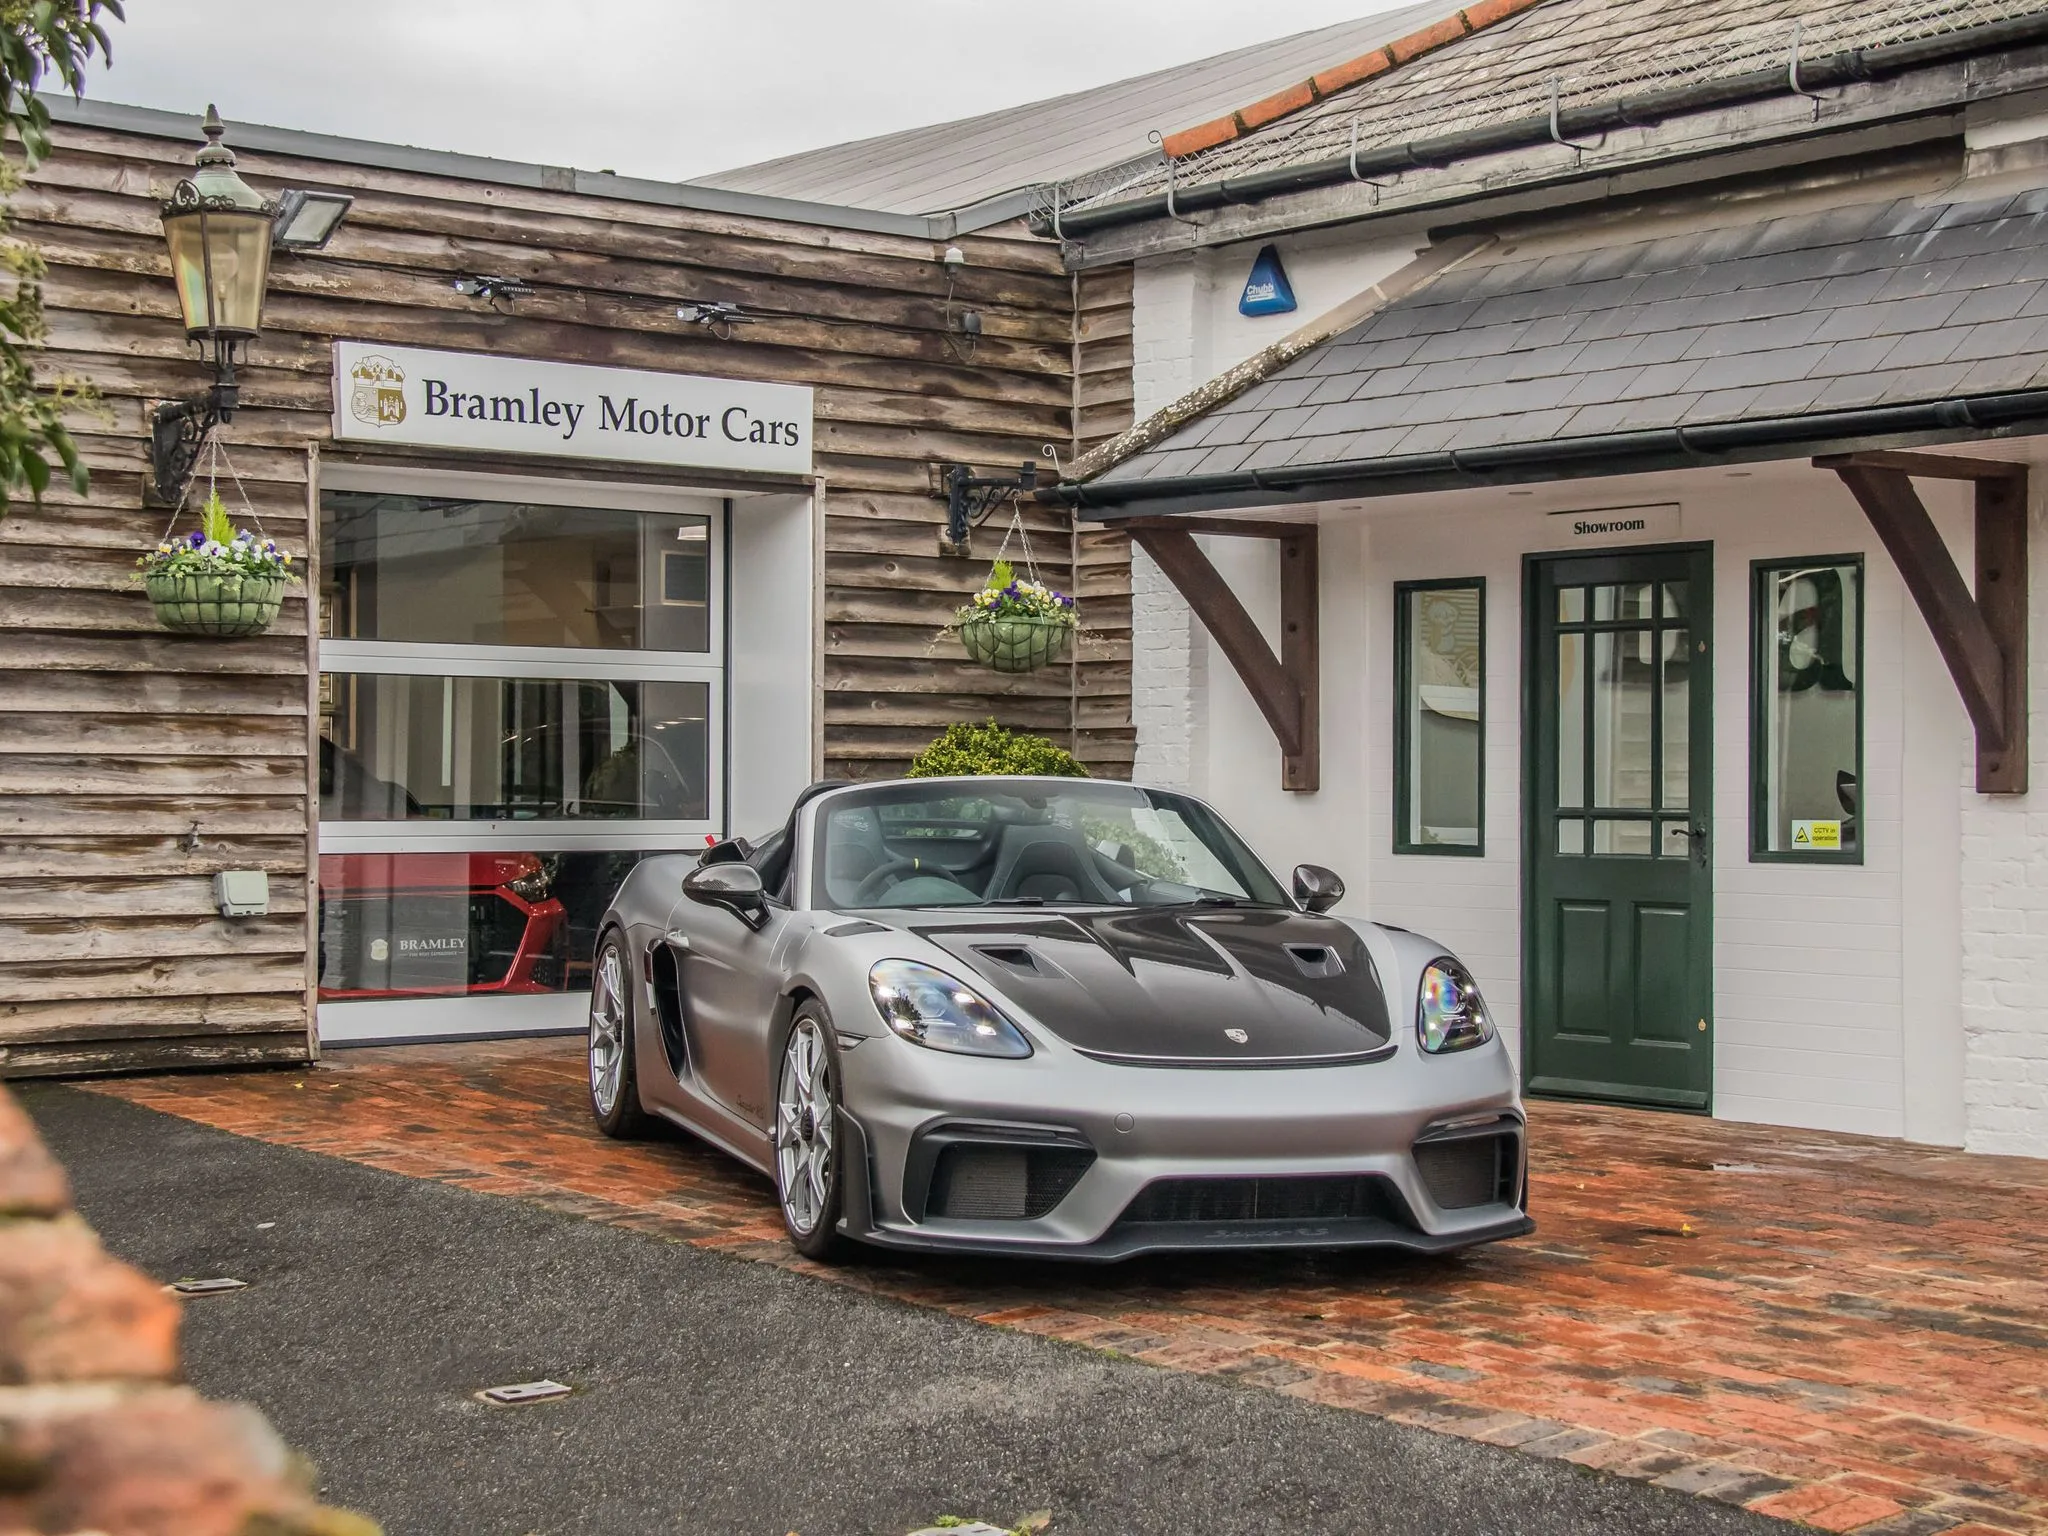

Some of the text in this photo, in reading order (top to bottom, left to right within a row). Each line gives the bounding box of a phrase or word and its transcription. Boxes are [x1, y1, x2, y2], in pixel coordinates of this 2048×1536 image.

[422, 379, 800, 447] Bramley Motor Cars
[1574, 519, 1645, 535] Showroom
[400, 938, 466, 950] BRAMLEY
